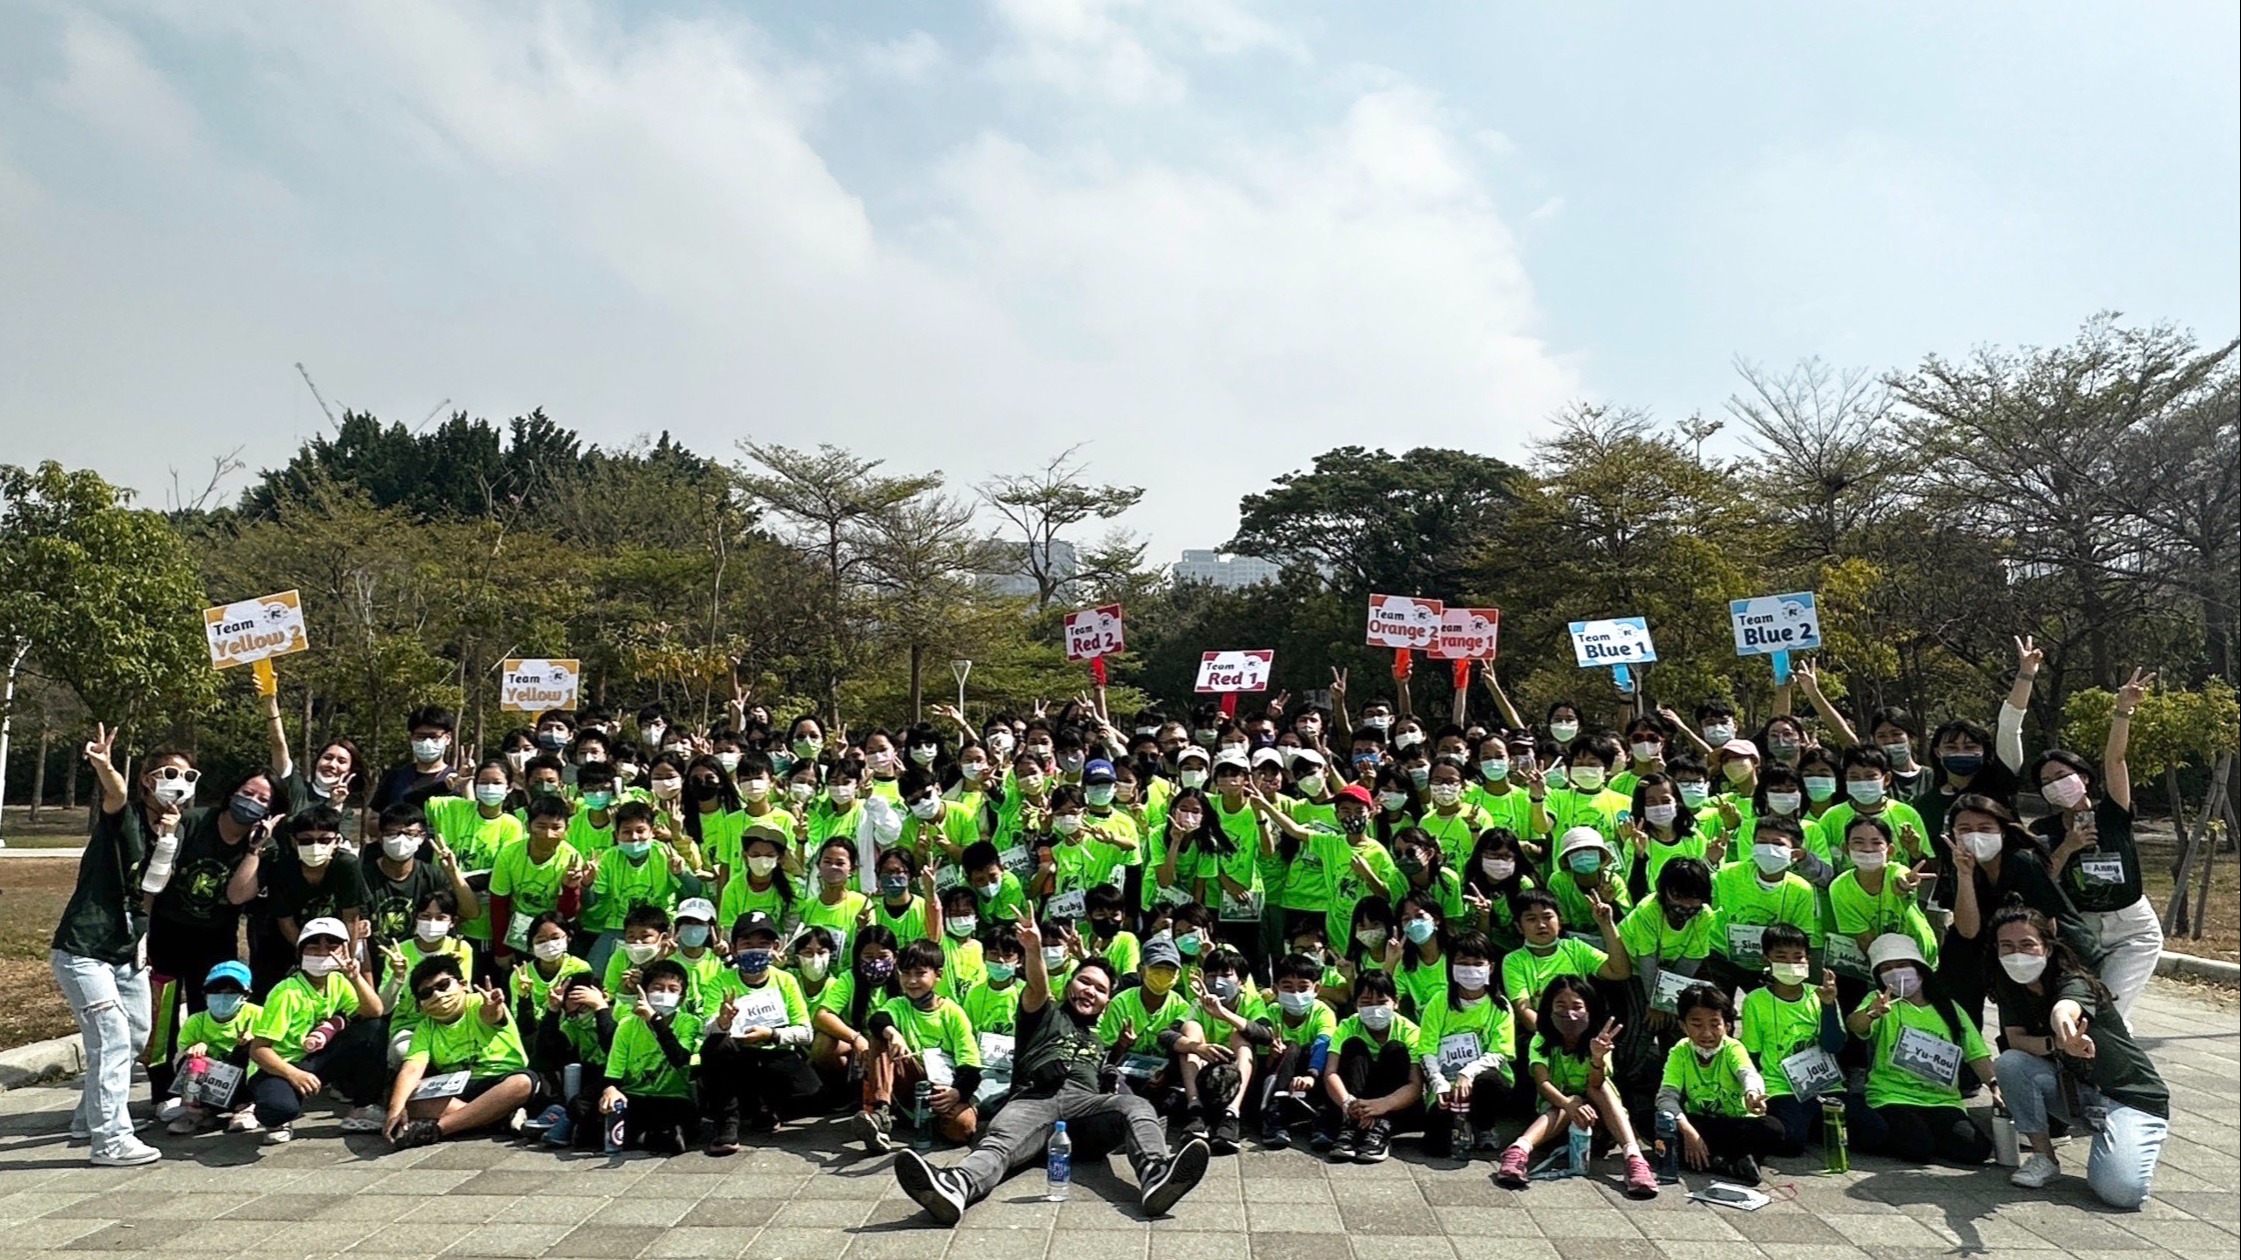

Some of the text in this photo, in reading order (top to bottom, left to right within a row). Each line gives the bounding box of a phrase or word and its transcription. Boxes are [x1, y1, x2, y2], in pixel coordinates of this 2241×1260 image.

[1374, 608, 1404, 620] Team
[1738, 614, 1774, 626] Team
[213, 619, 254, 636] Team
[1069, 625, 1093, 636] Team
[1369, 620, 1439, 640] Orange 2
[1441, 624, 1463, 632] eam
[1743, 622, 1813, 646] Blue 2
[214, 624, 304, 657] Yellow 2
[1073, 632, 1114, 653] Red 2
[1441, 635, 1493, 651] range 1
[1577, 634, 1611, 642] Team
[1584, 641, 1646, 659] Blue 1
[1206, 662, 1235, 670] Team
[508, 674, 540, 683] Team
[1208, 671, 1258, 685] Red 1
[506, 687, 574, 701] Yellow 1
[936, 876, 955, 889] ouis
[1058, 902, 1083, 913] Ruby
[747, 1001, 776, 1017] Kimi
[1446, 1047, 1473, 1063] Julie
[1915, 1047, 1953, 1069] Yu-Rou
[197, 1072, 230, 1090] iana
